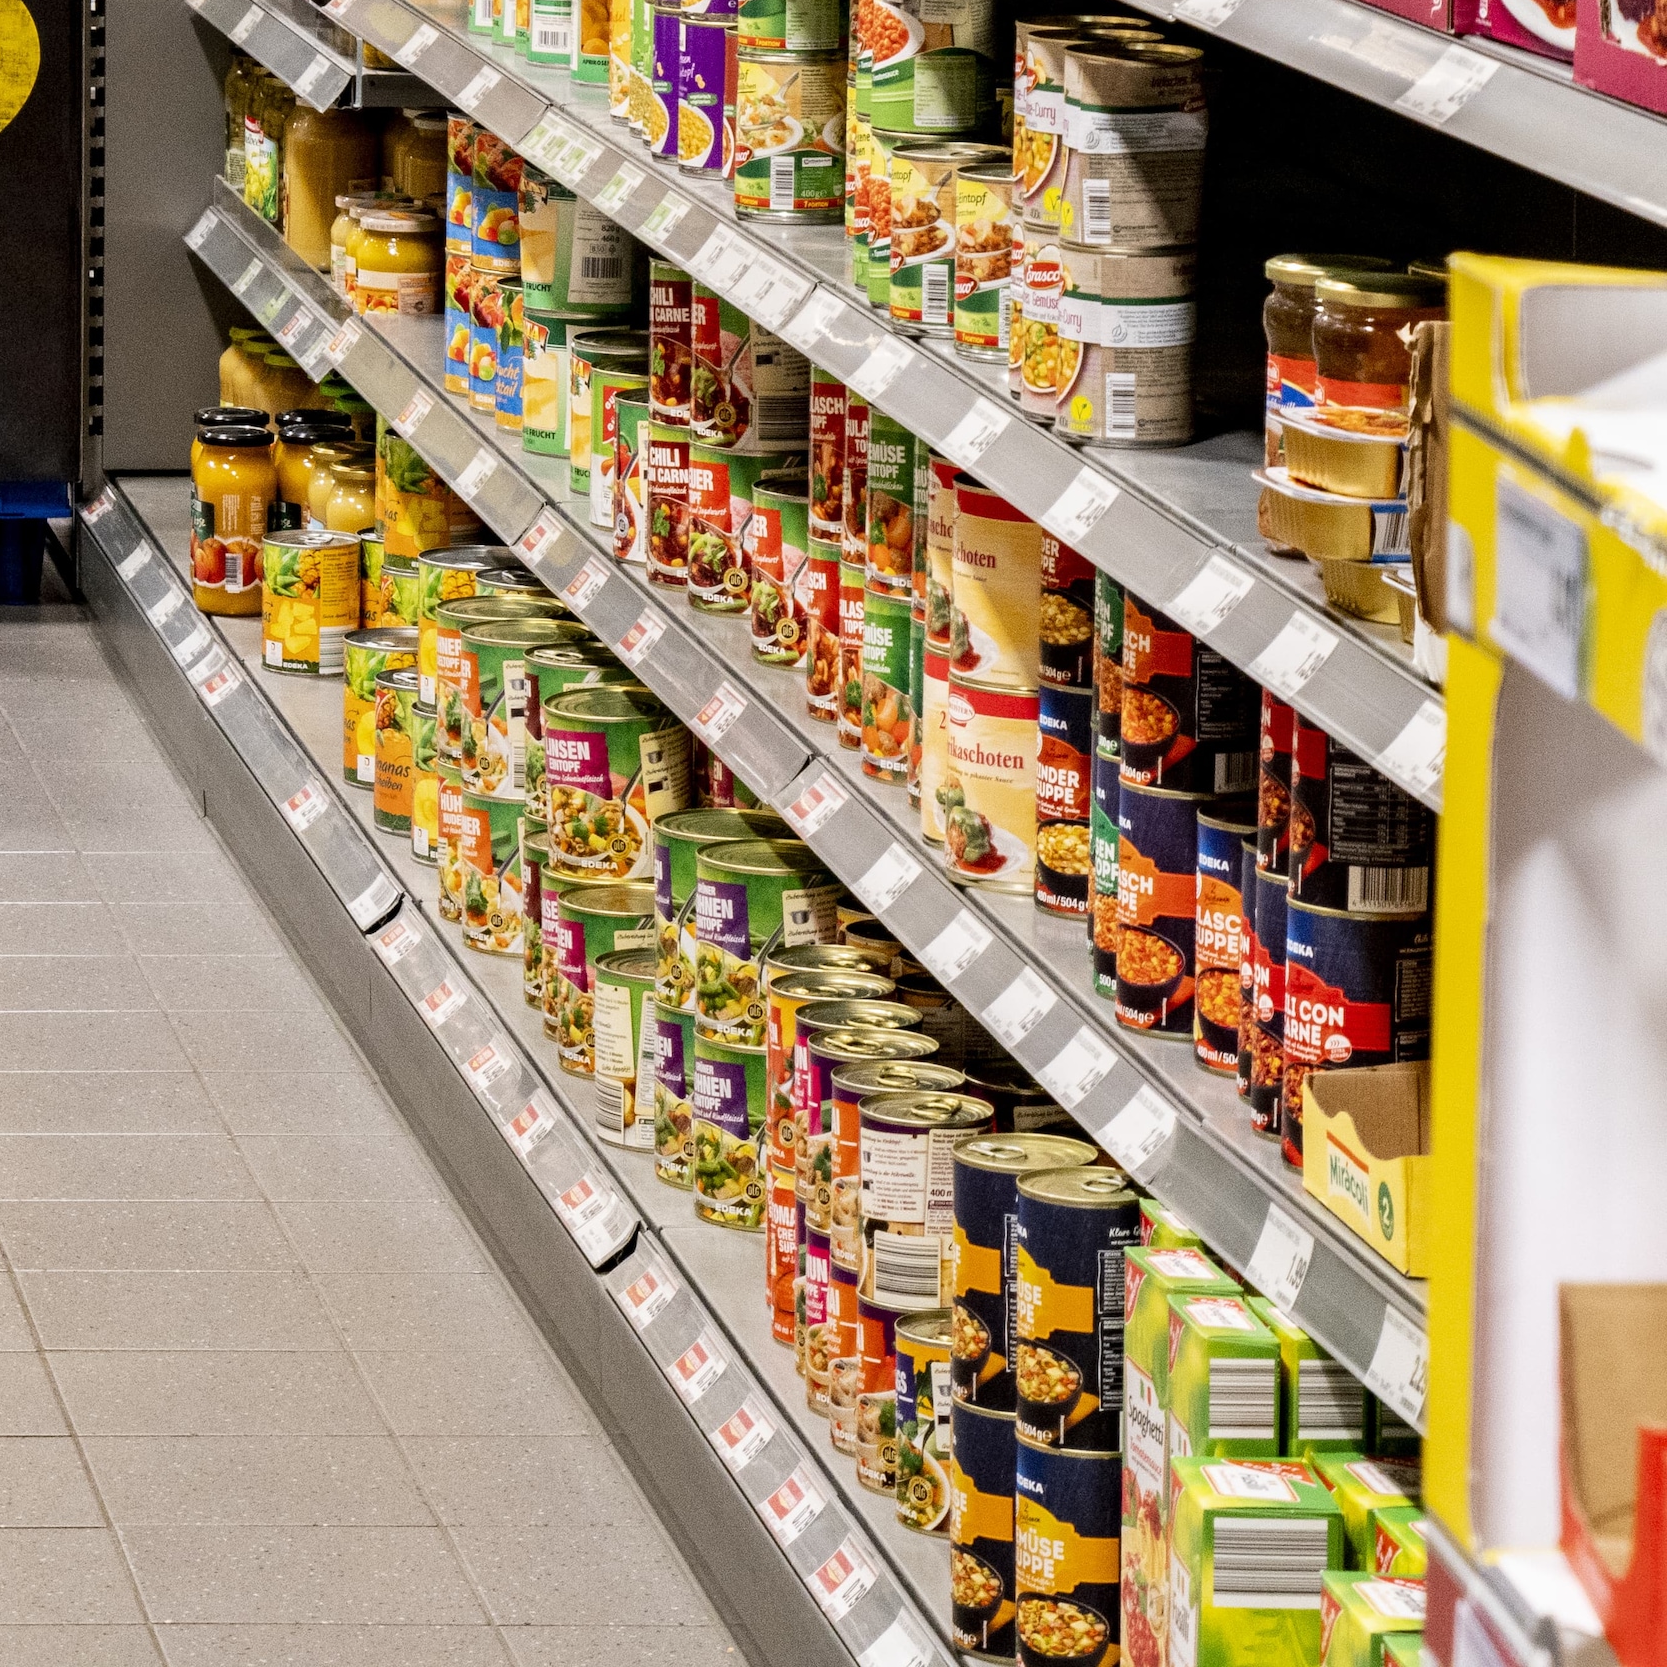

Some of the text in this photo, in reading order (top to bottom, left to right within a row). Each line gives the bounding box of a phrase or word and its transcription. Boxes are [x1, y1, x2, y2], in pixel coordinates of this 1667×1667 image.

[702, 595, 734, 604] EDEKA
[758, 644, 785, 655] EDEKA
[546, 737, 590, 760] LINSEN
[548, 757, 581, 774] EINTOPF
[581, 860, 618, 870] EDEKA
[1299, 1001, 1345, 1025] CON
[717, 1026, 753, 1037] EDEKA
[716, 1206, 751, 1217] EDEKA
[1381, 1198, 1392, 1219] 2
[1128, 1390, 1165, 1447] Spaghetti
